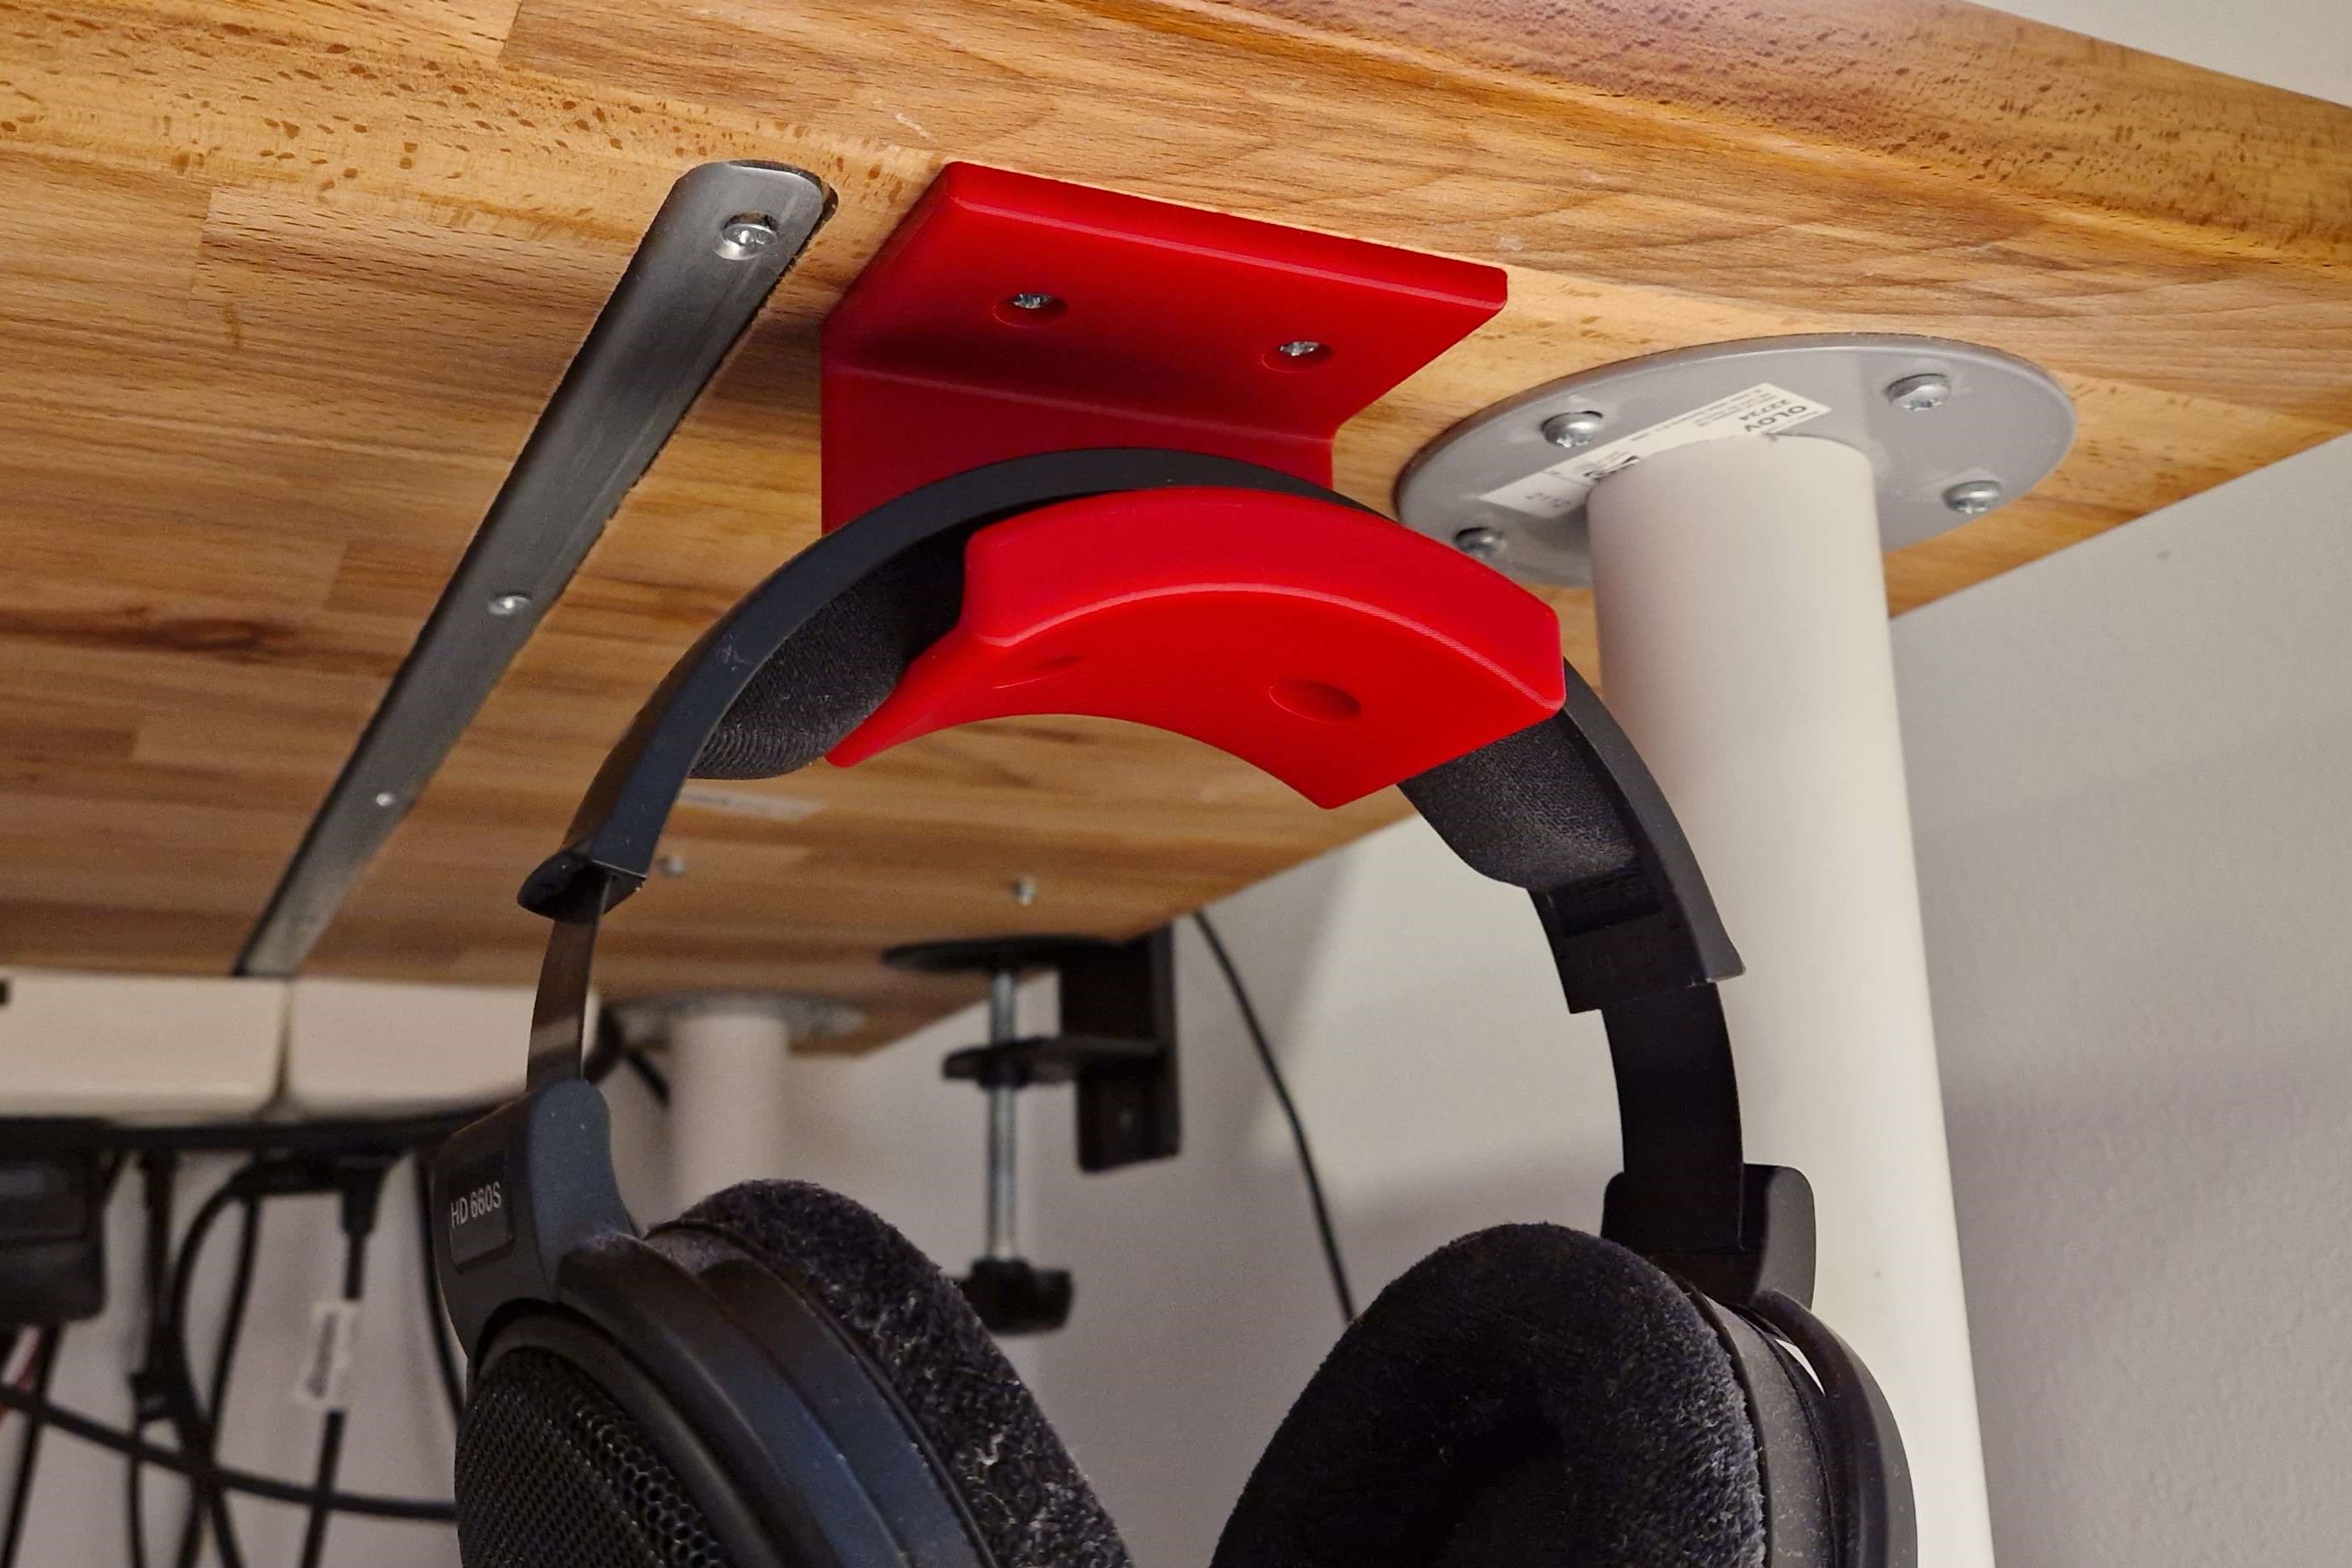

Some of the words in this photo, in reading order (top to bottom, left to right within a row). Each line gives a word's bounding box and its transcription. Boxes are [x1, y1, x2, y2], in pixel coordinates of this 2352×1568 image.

[1744, 406, 1806, 432] OLOV
[451, 1197, 468, 1229] HD
[471, 1181, 501, 1218] 660S
